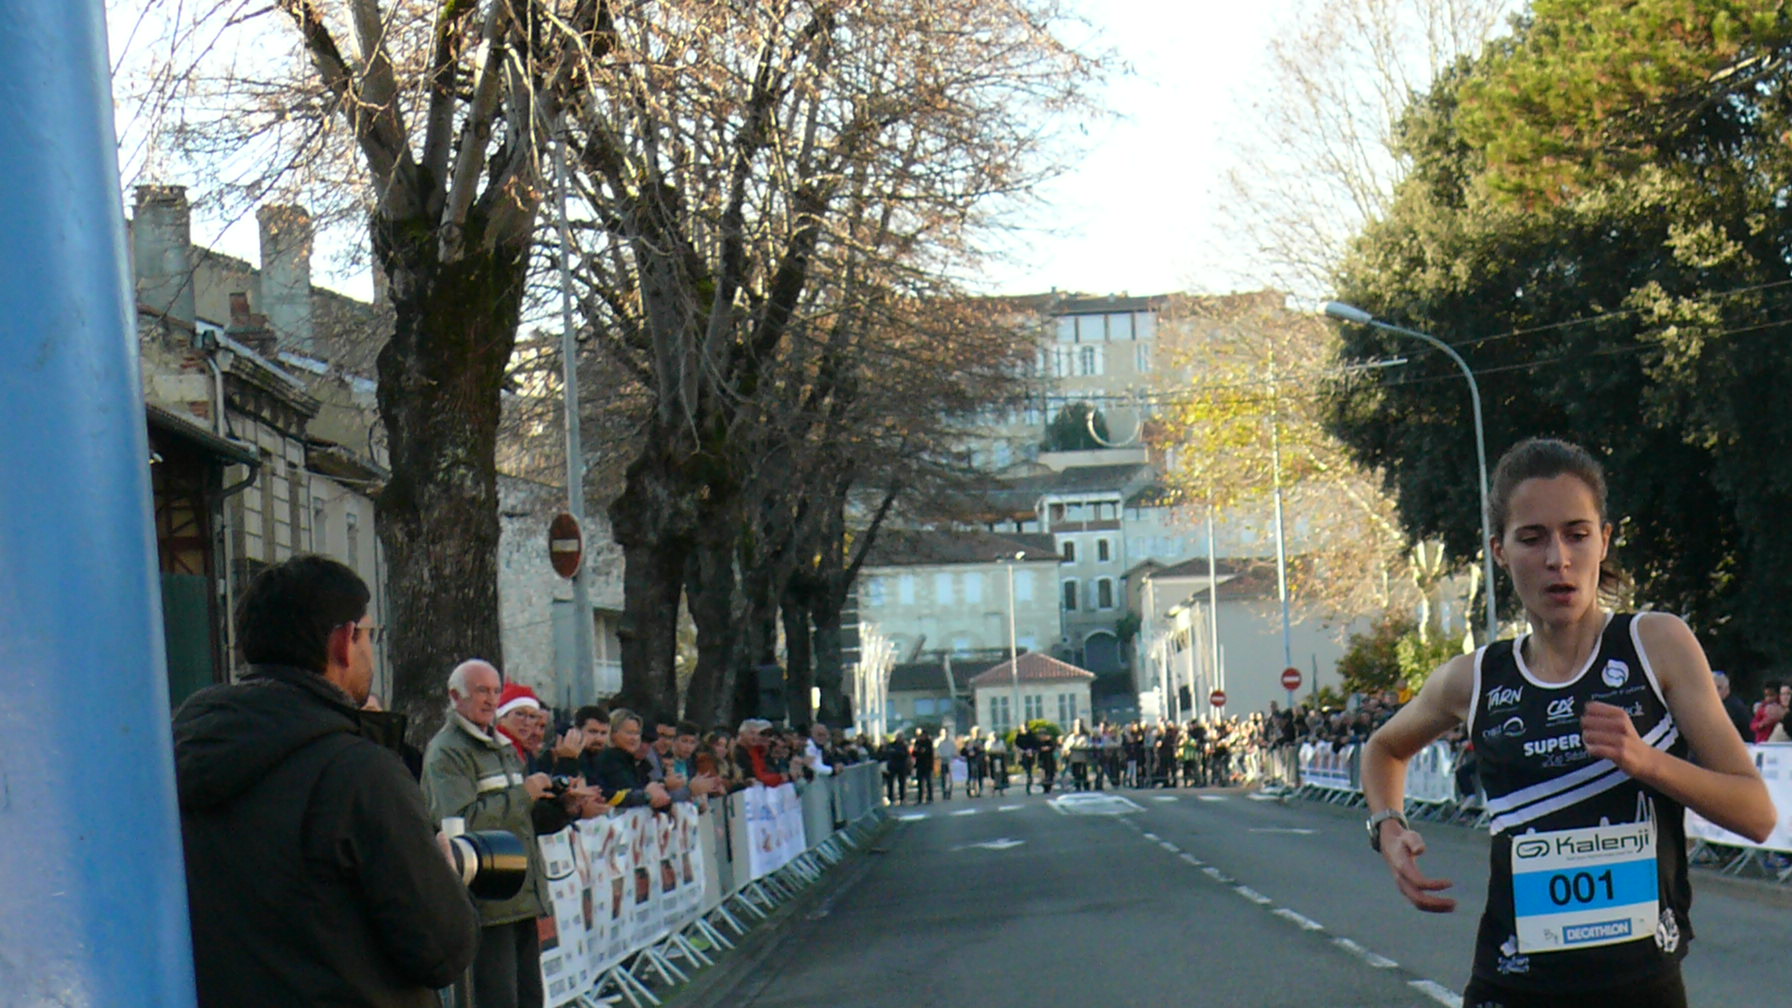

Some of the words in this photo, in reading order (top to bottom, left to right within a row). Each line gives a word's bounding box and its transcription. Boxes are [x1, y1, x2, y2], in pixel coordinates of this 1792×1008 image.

[1486, 684, 1524, 711] TARN
[1523, 733, 1582, 757] SUPER
[1556, 828, 1650, 855] Kalenji
[1549, 868, 1615, 906] 001
[1566, 920, 1629, 941] DECATHLON
